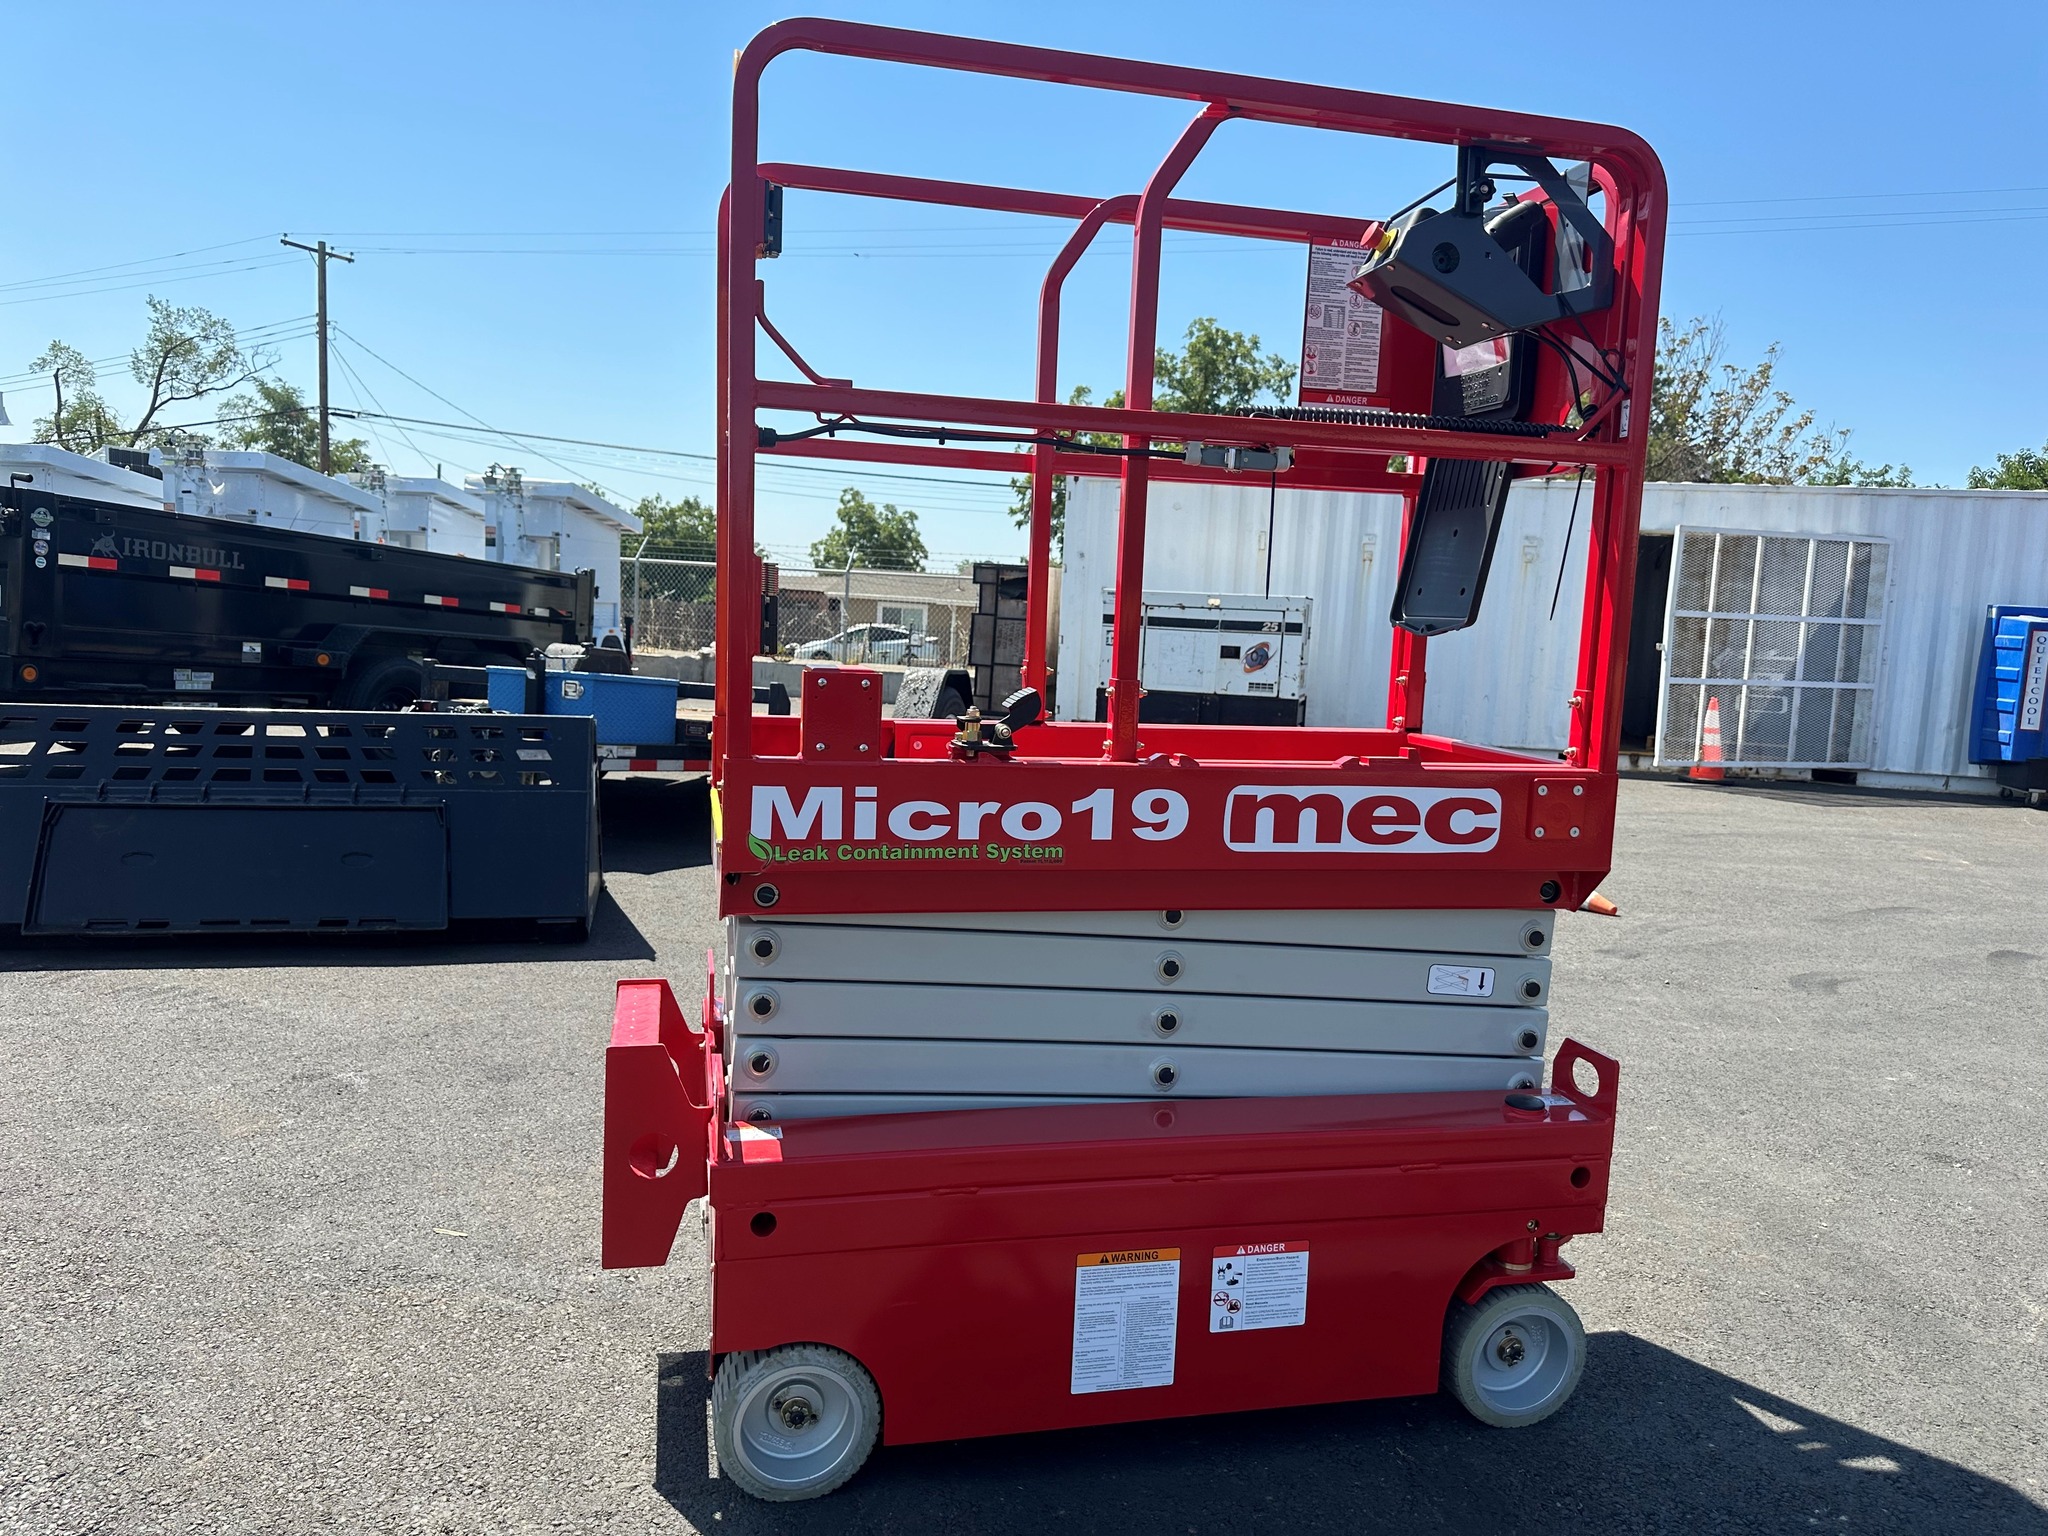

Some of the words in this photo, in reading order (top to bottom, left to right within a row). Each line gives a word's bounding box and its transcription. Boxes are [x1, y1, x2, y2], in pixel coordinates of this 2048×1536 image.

[1335, 395, 1368, 405] DANGER
[122, 537, 245, 569] IRONBULL
[1261, 621, 1279, 632] 25
[2027, 635, 2047, 726] QUIETCOOL
[751, 785, 1190, 841] Micro19
[1229, 793, 1498, 845] mec
[774, 844, 829, 861] Leak
[837, 844, 979, 861] Containment
[986, 843, 1064, 863] System
[1111, 1251, 1159, 1262] WARNING
[1247, 1243, 1286, 1254] DANGER
